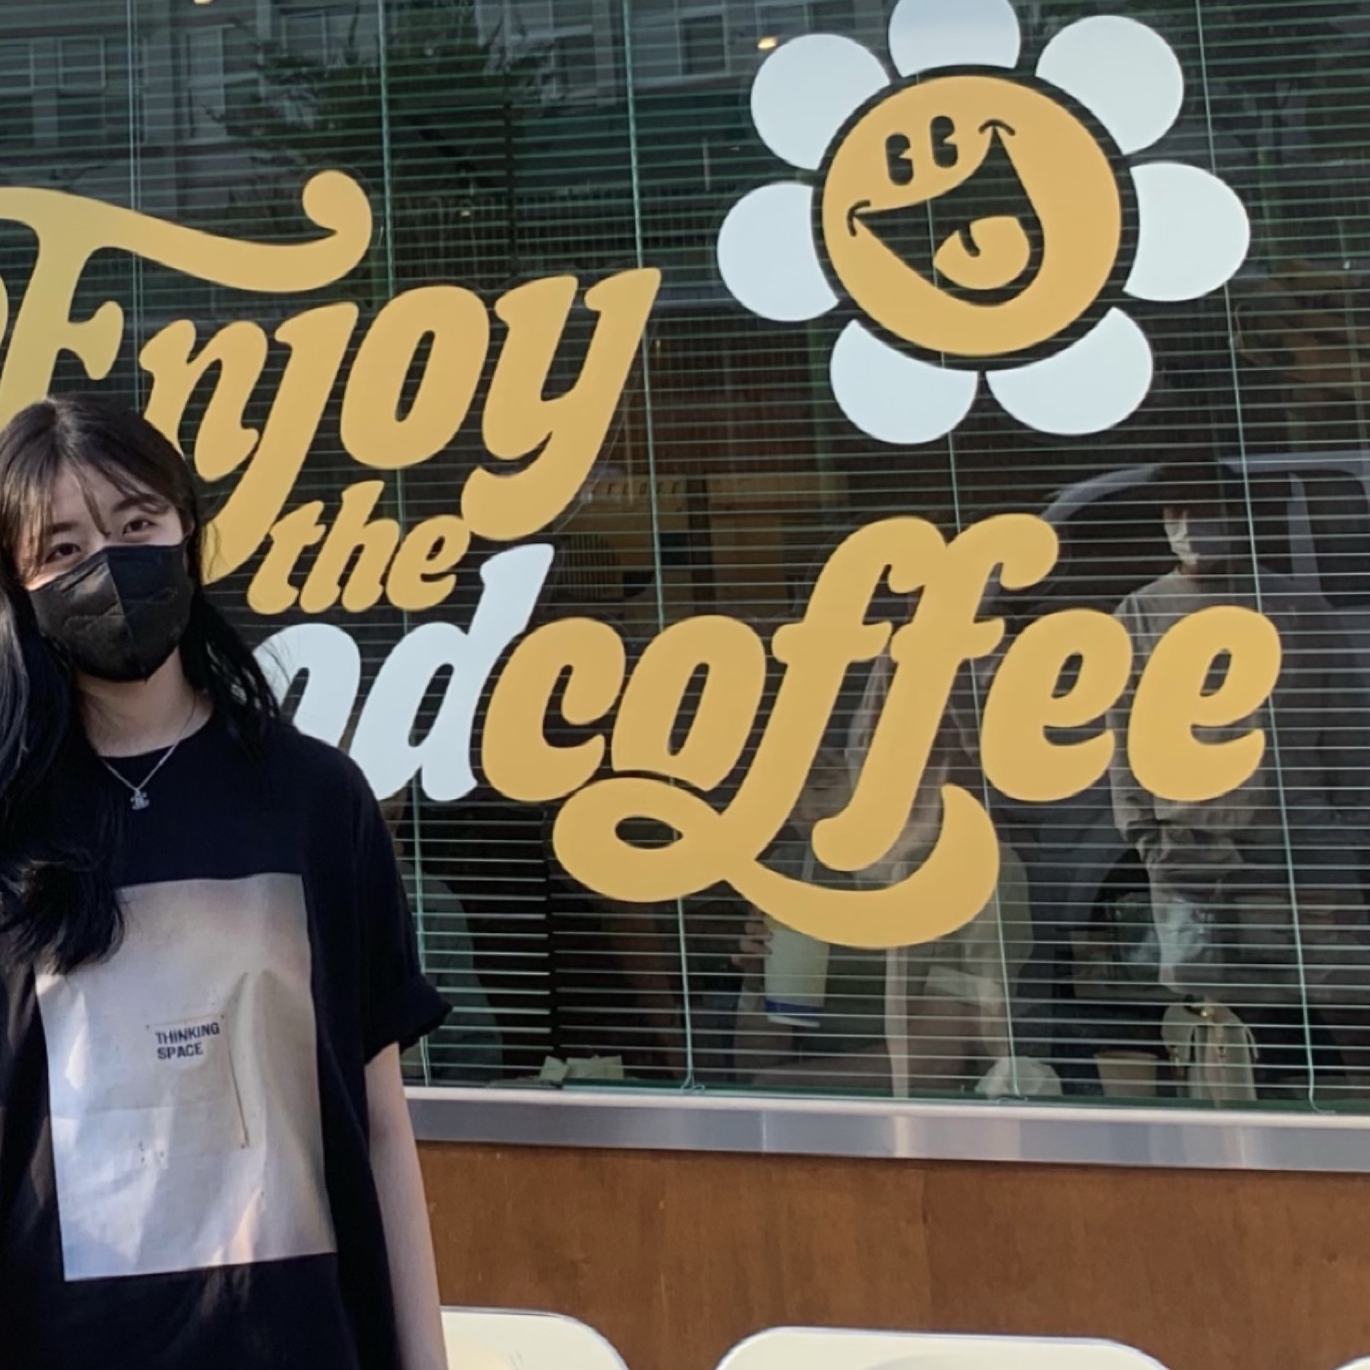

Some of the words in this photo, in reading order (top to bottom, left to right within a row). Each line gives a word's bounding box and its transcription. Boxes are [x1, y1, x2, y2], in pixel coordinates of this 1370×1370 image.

[246, 480, 472, 615] the
[154, 1020, 221, 1046] THINKING
[156, 1041, 204, 1060] SPACE
